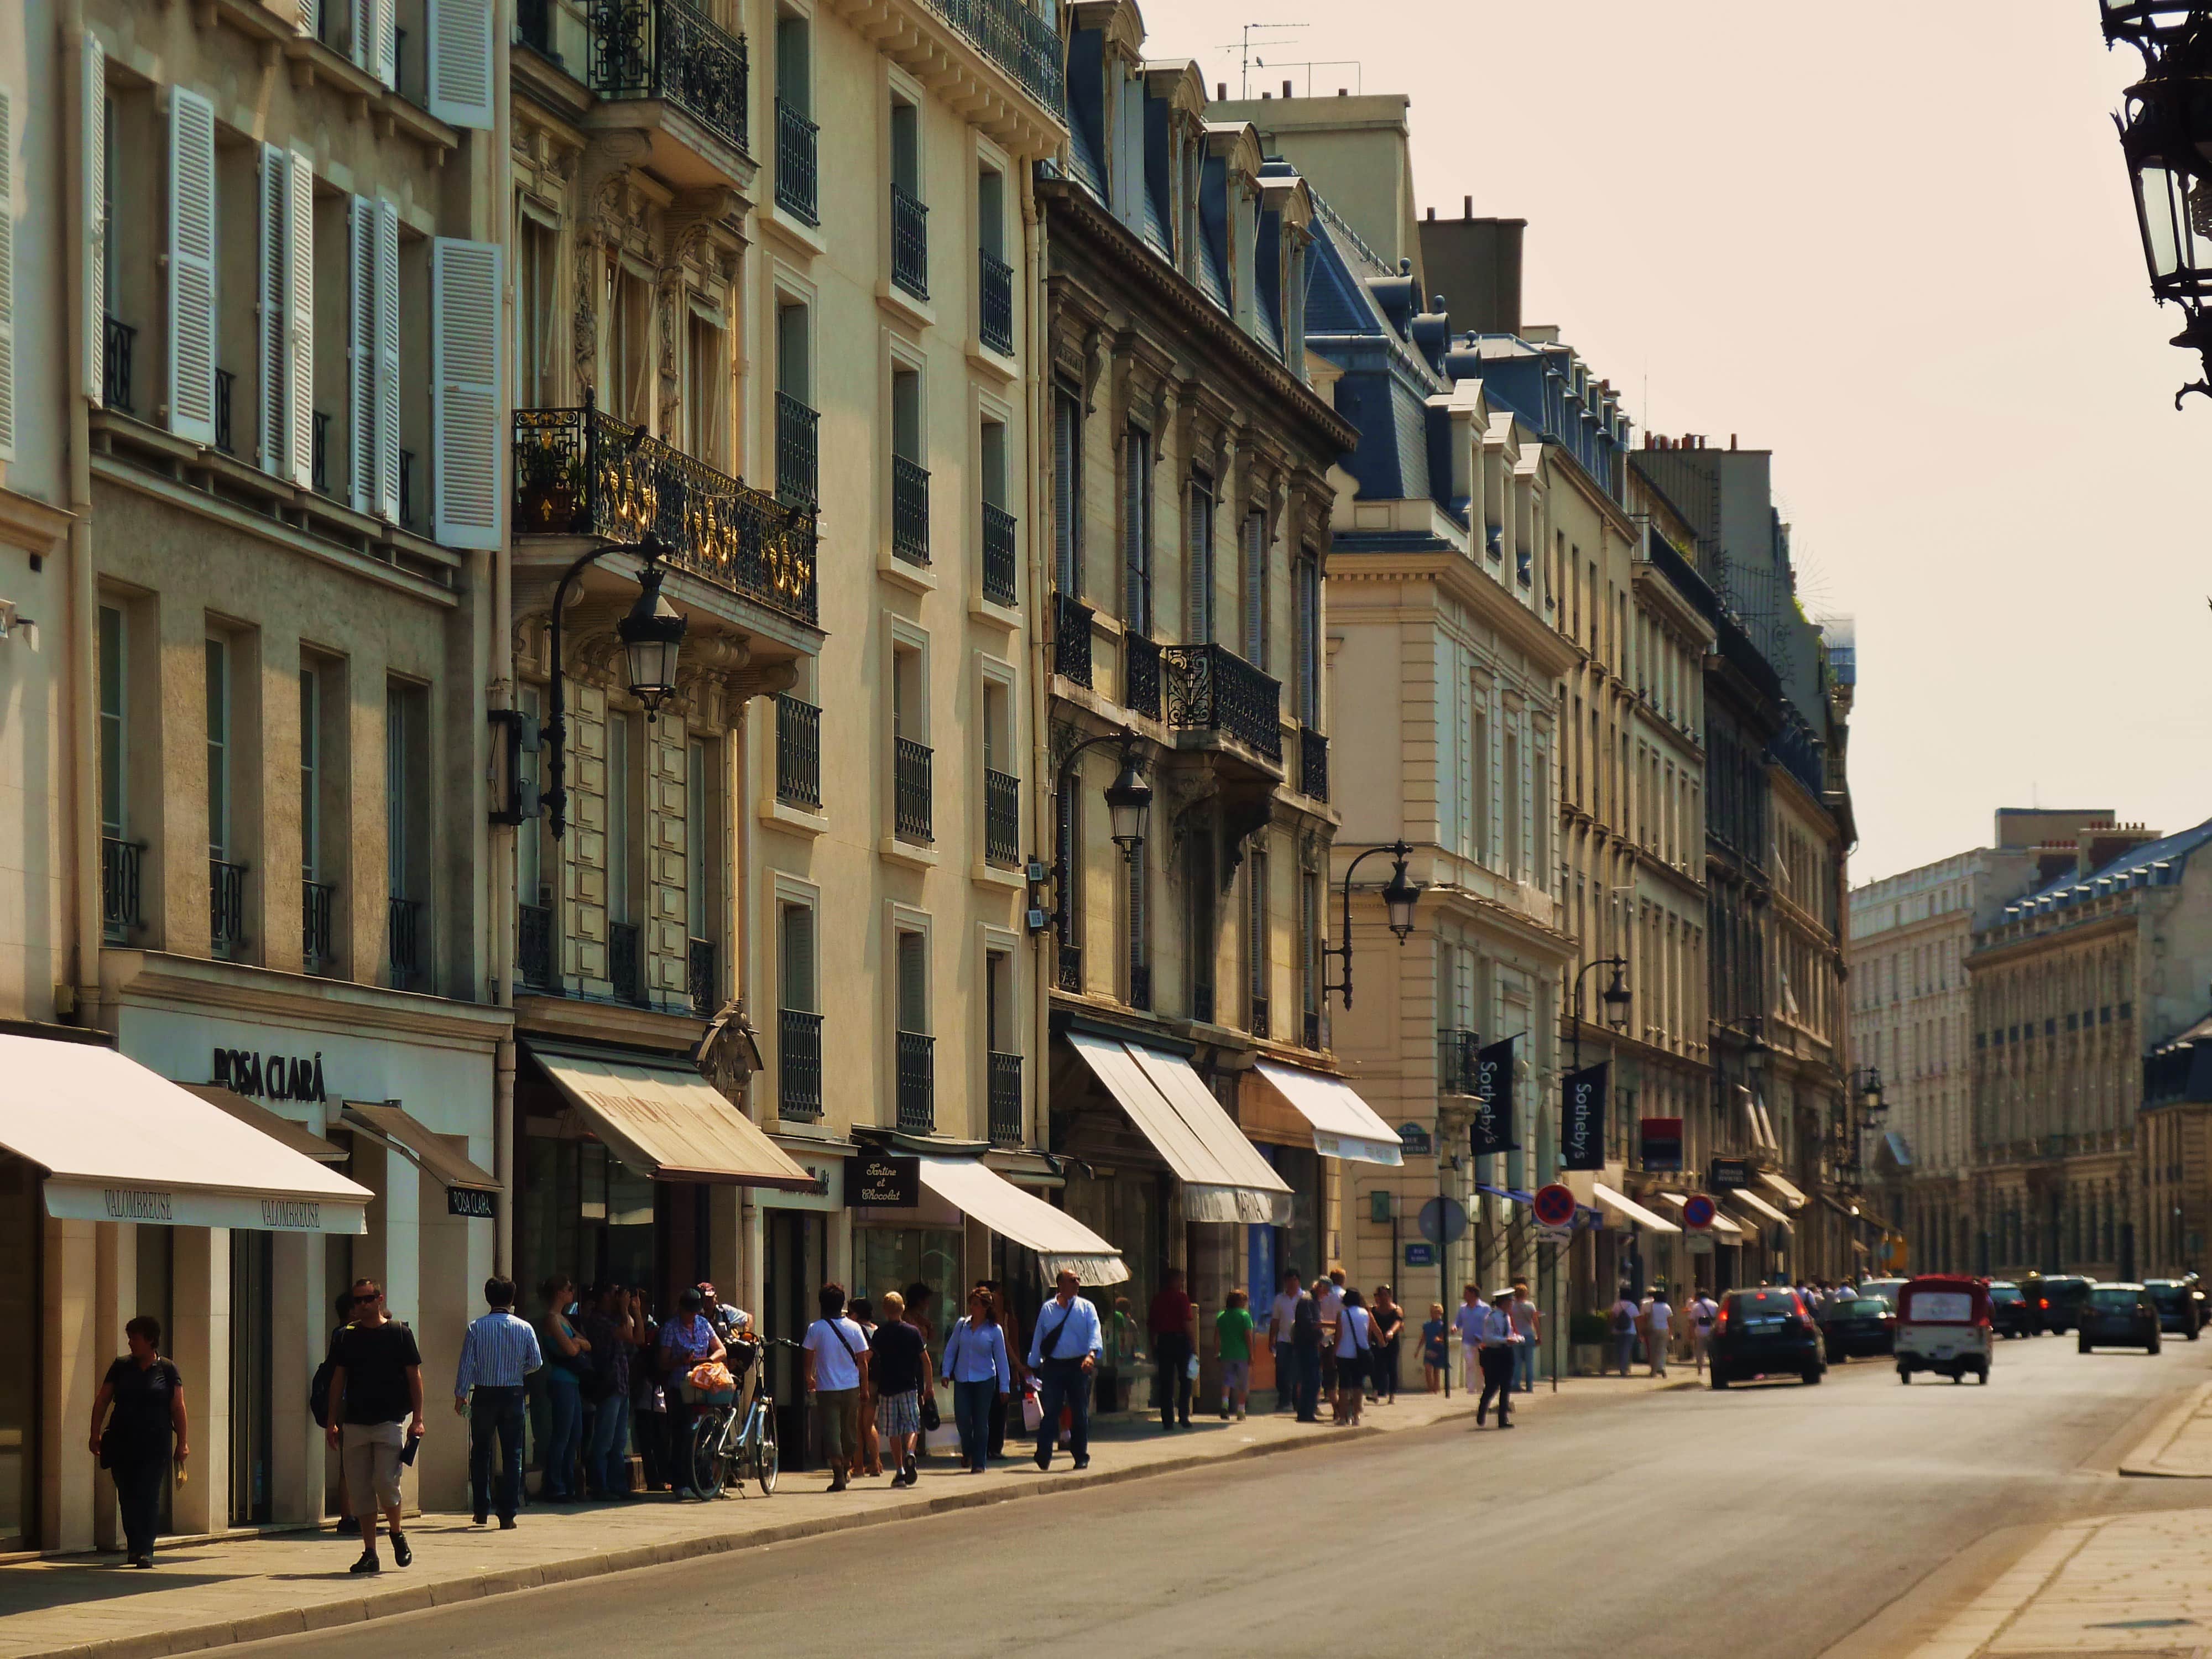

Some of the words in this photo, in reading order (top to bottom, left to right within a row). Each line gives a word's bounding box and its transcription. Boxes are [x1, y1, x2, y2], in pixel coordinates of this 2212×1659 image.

[214, 1047, 264, 1097] ROSA
[1479, 1061, 1498, 1144] Sotheby's
[1571, 1083, 1592, 1159] Sotheby's
[867, 1163, 896, 1176] Tartine
[877, 1177, 885, 1187] et
[105, 1190, 172, 1220] VALOMBREUSE
[862, 1189, 900, 1200] Chocolat
[261, 1199, 320, 1228] VALOMBREUSE
